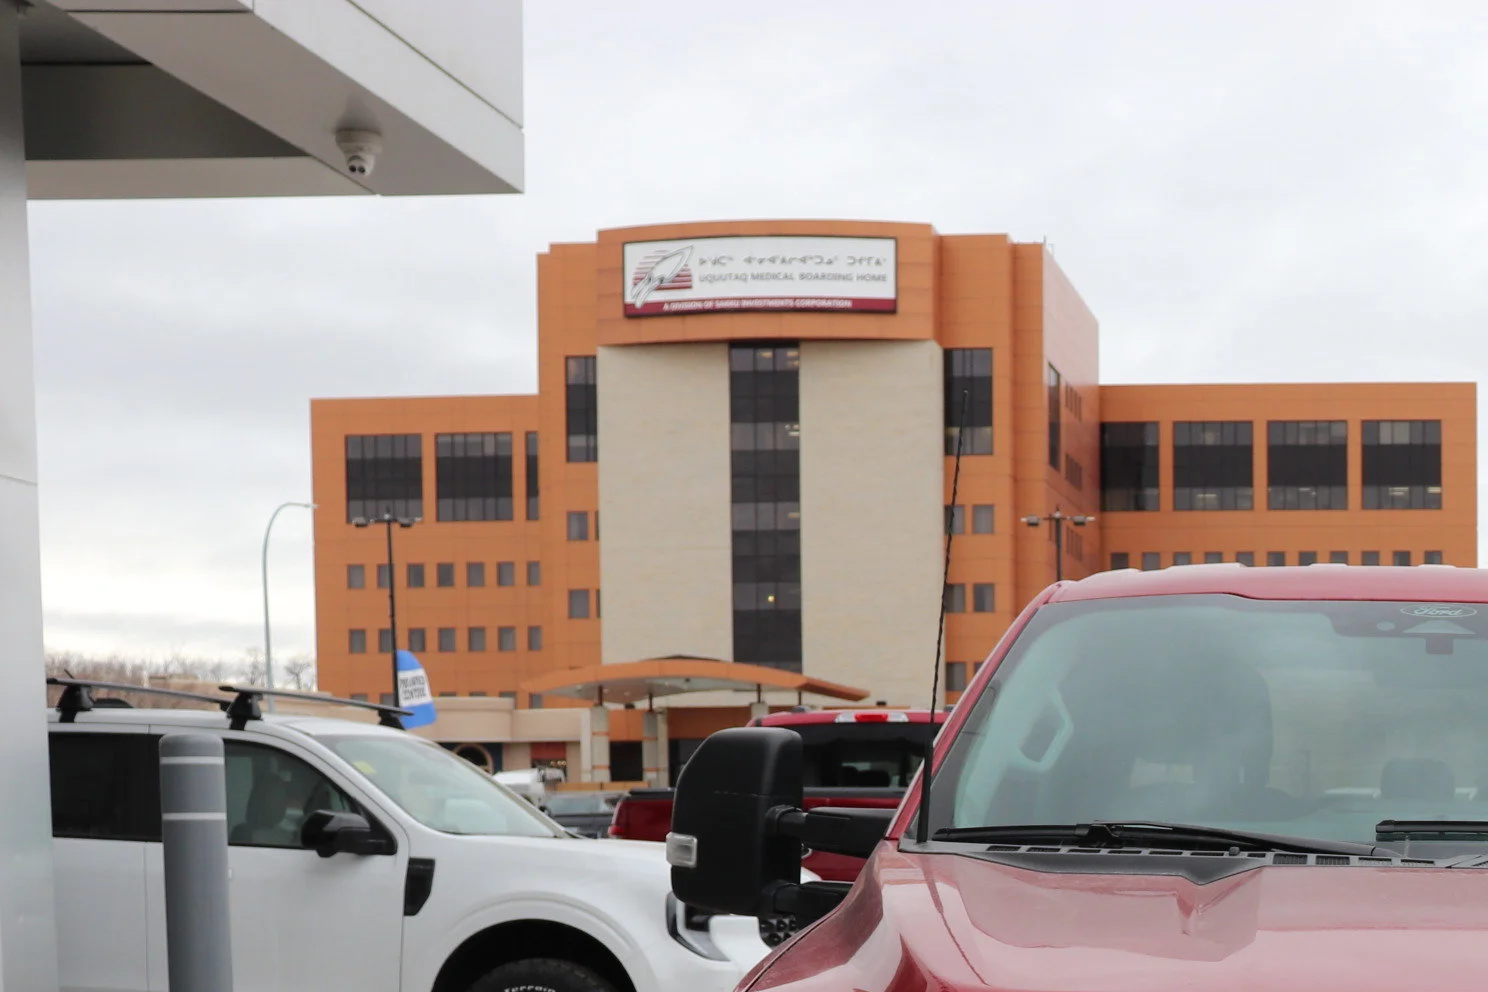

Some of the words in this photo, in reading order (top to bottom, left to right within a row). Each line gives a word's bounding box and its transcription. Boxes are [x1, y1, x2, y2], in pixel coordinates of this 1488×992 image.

[750, 271, 794, 281] MEDICAL
[799, 271, 854, 281] BOARDING
[856, 272, 887, 281] HOME
[1413, 605, 1463, 616] Ford
